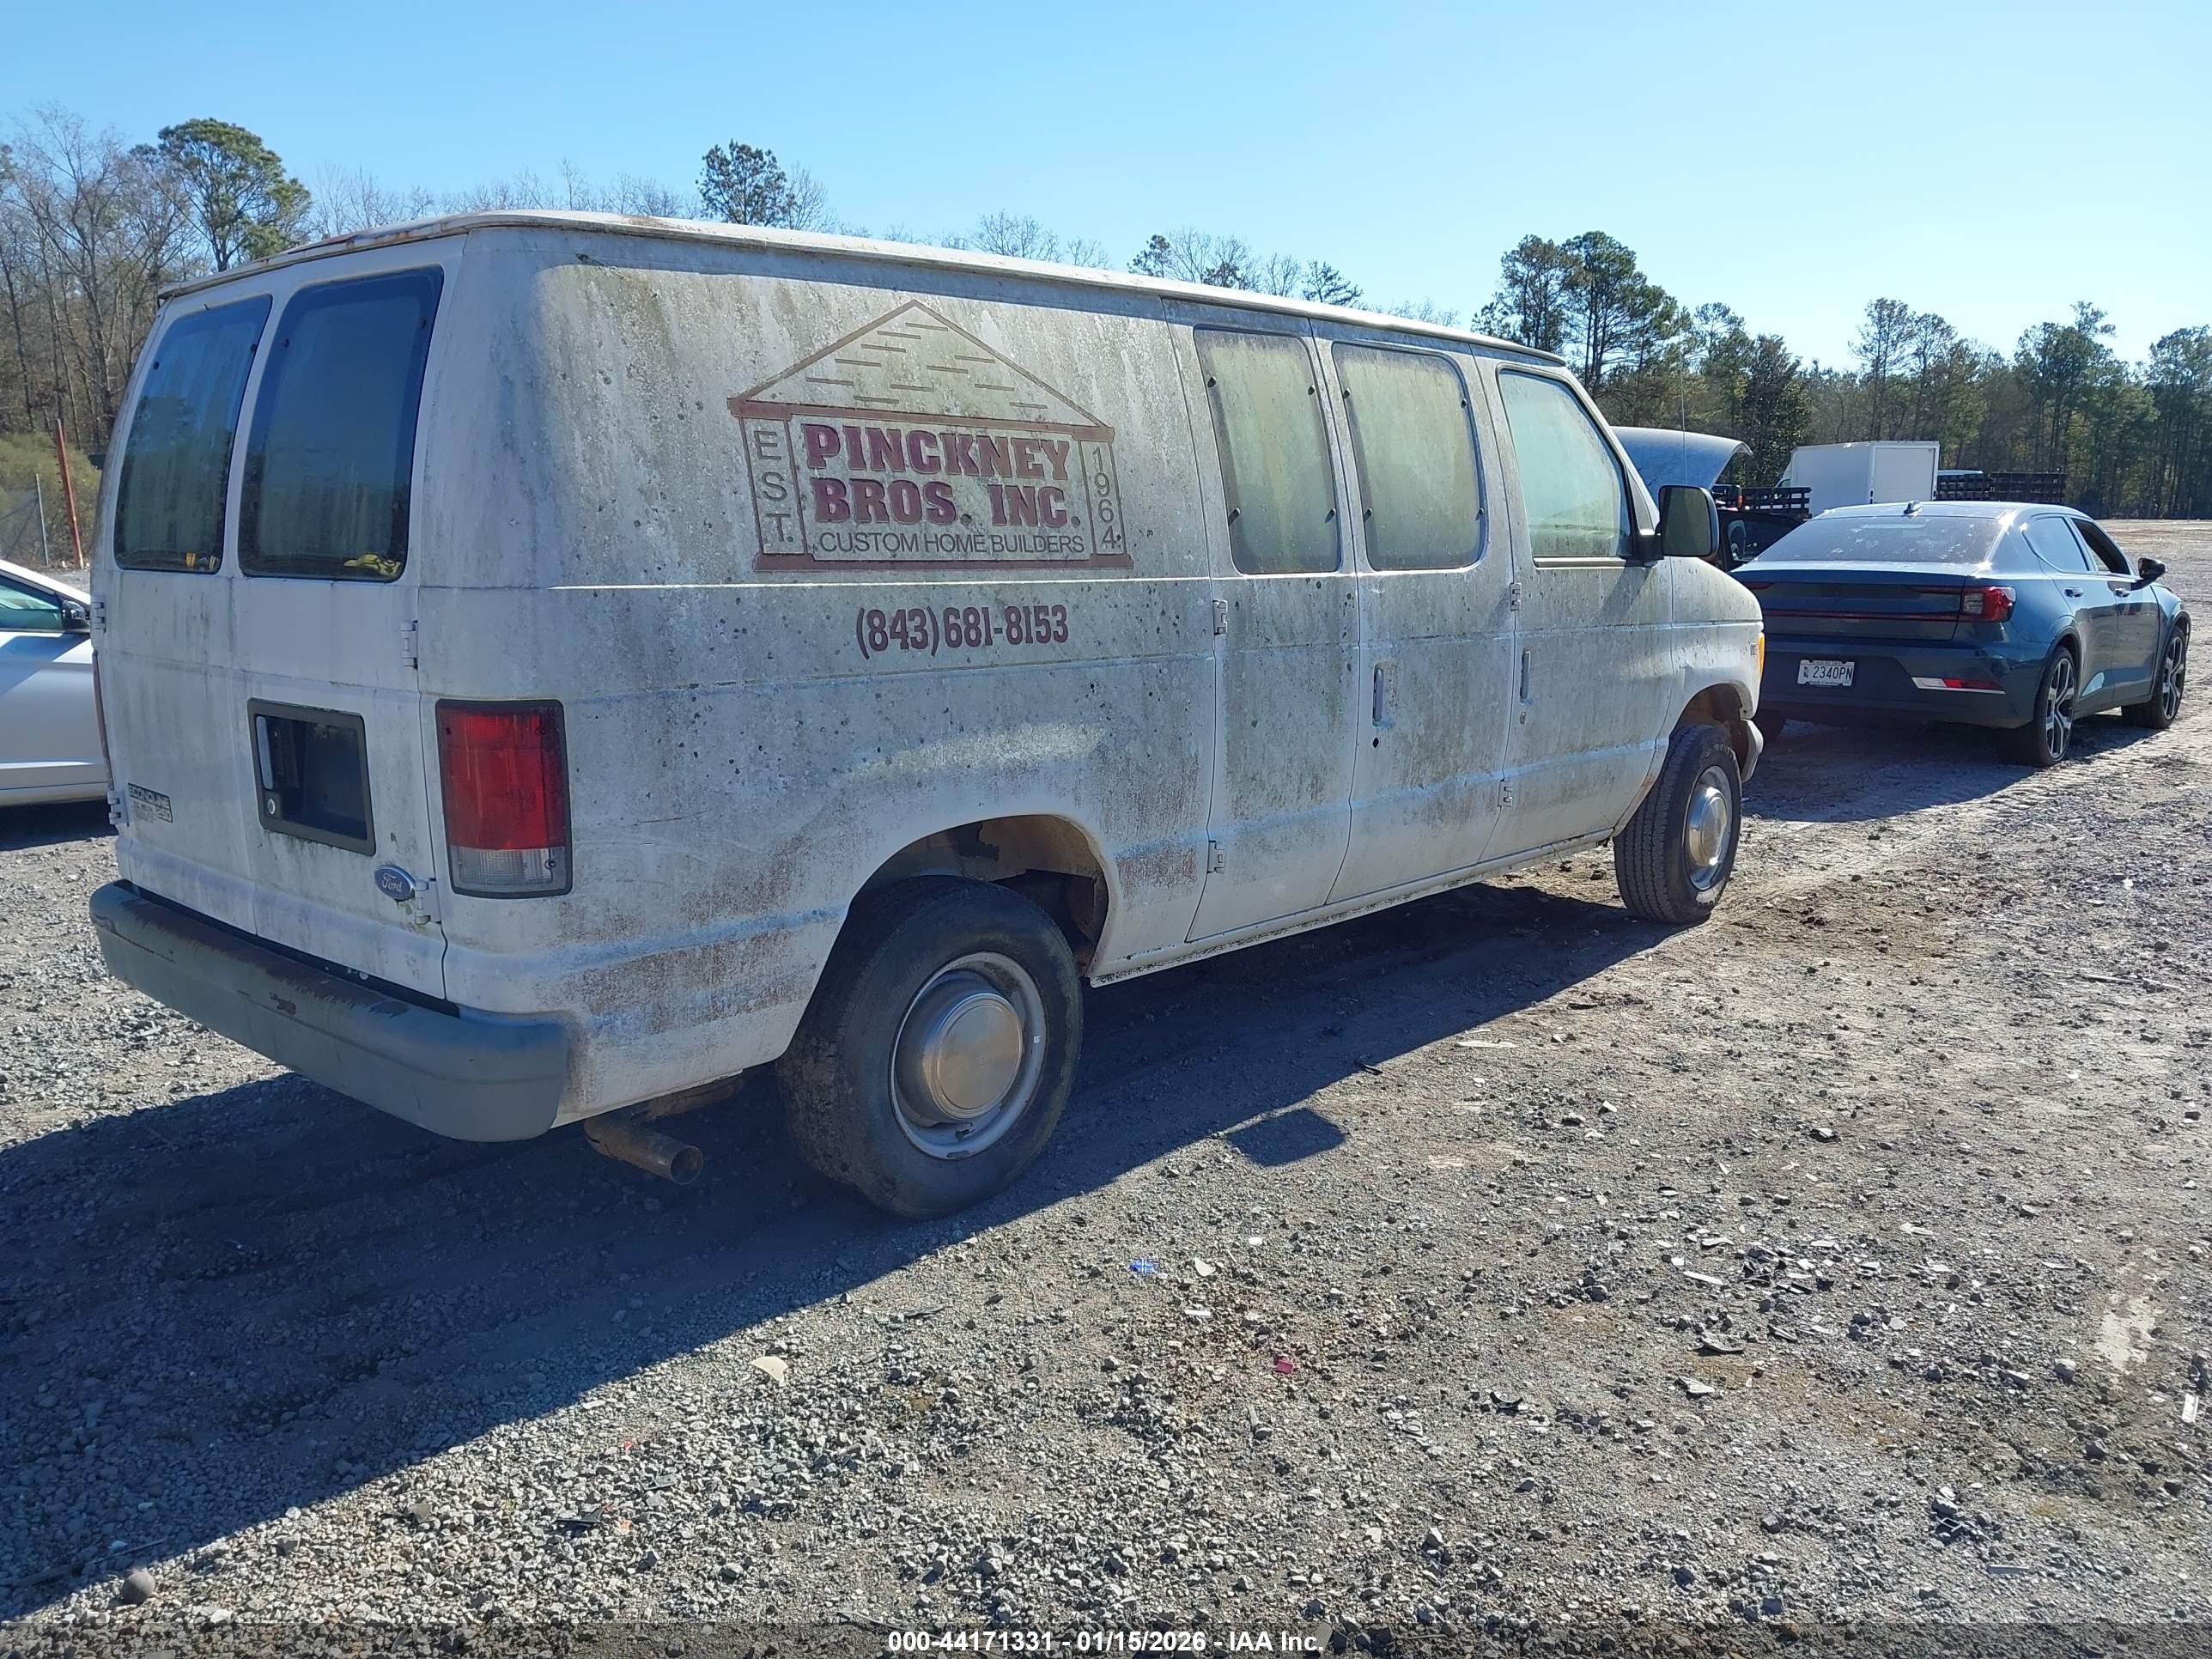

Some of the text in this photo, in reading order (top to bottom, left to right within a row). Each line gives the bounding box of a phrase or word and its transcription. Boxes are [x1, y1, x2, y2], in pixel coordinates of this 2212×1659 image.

[801, 423, 1071, 481] PINCKNEY
[755, 430, 794, 543] EST.
[810, 477, 1081, 528] BROS. INC.
[1091, 447, 1119, 549] 1964
[818, 532, 1085, 555] CUSTOM HOME BUILDERS
[381, 872, 403, 893] Ford
